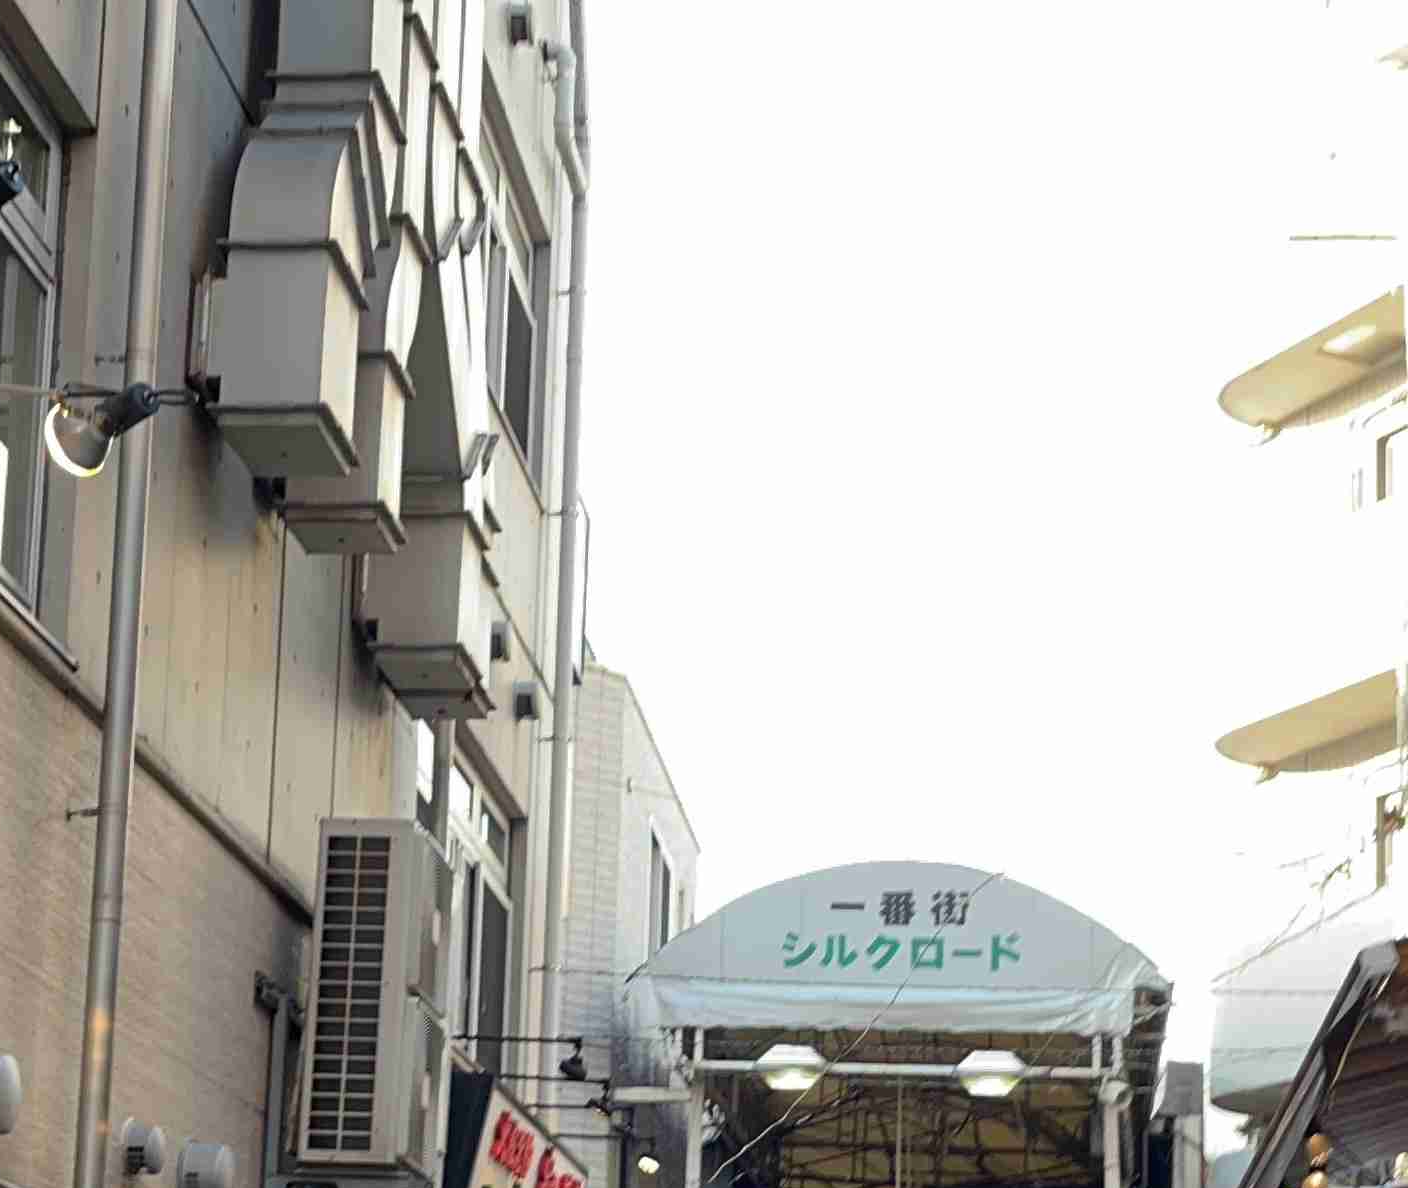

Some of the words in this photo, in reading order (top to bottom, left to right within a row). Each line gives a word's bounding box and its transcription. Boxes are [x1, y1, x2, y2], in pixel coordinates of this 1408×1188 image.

[830, 889, 970, 926] 一番街
[781, 932, 1021, 973] シルクロード
